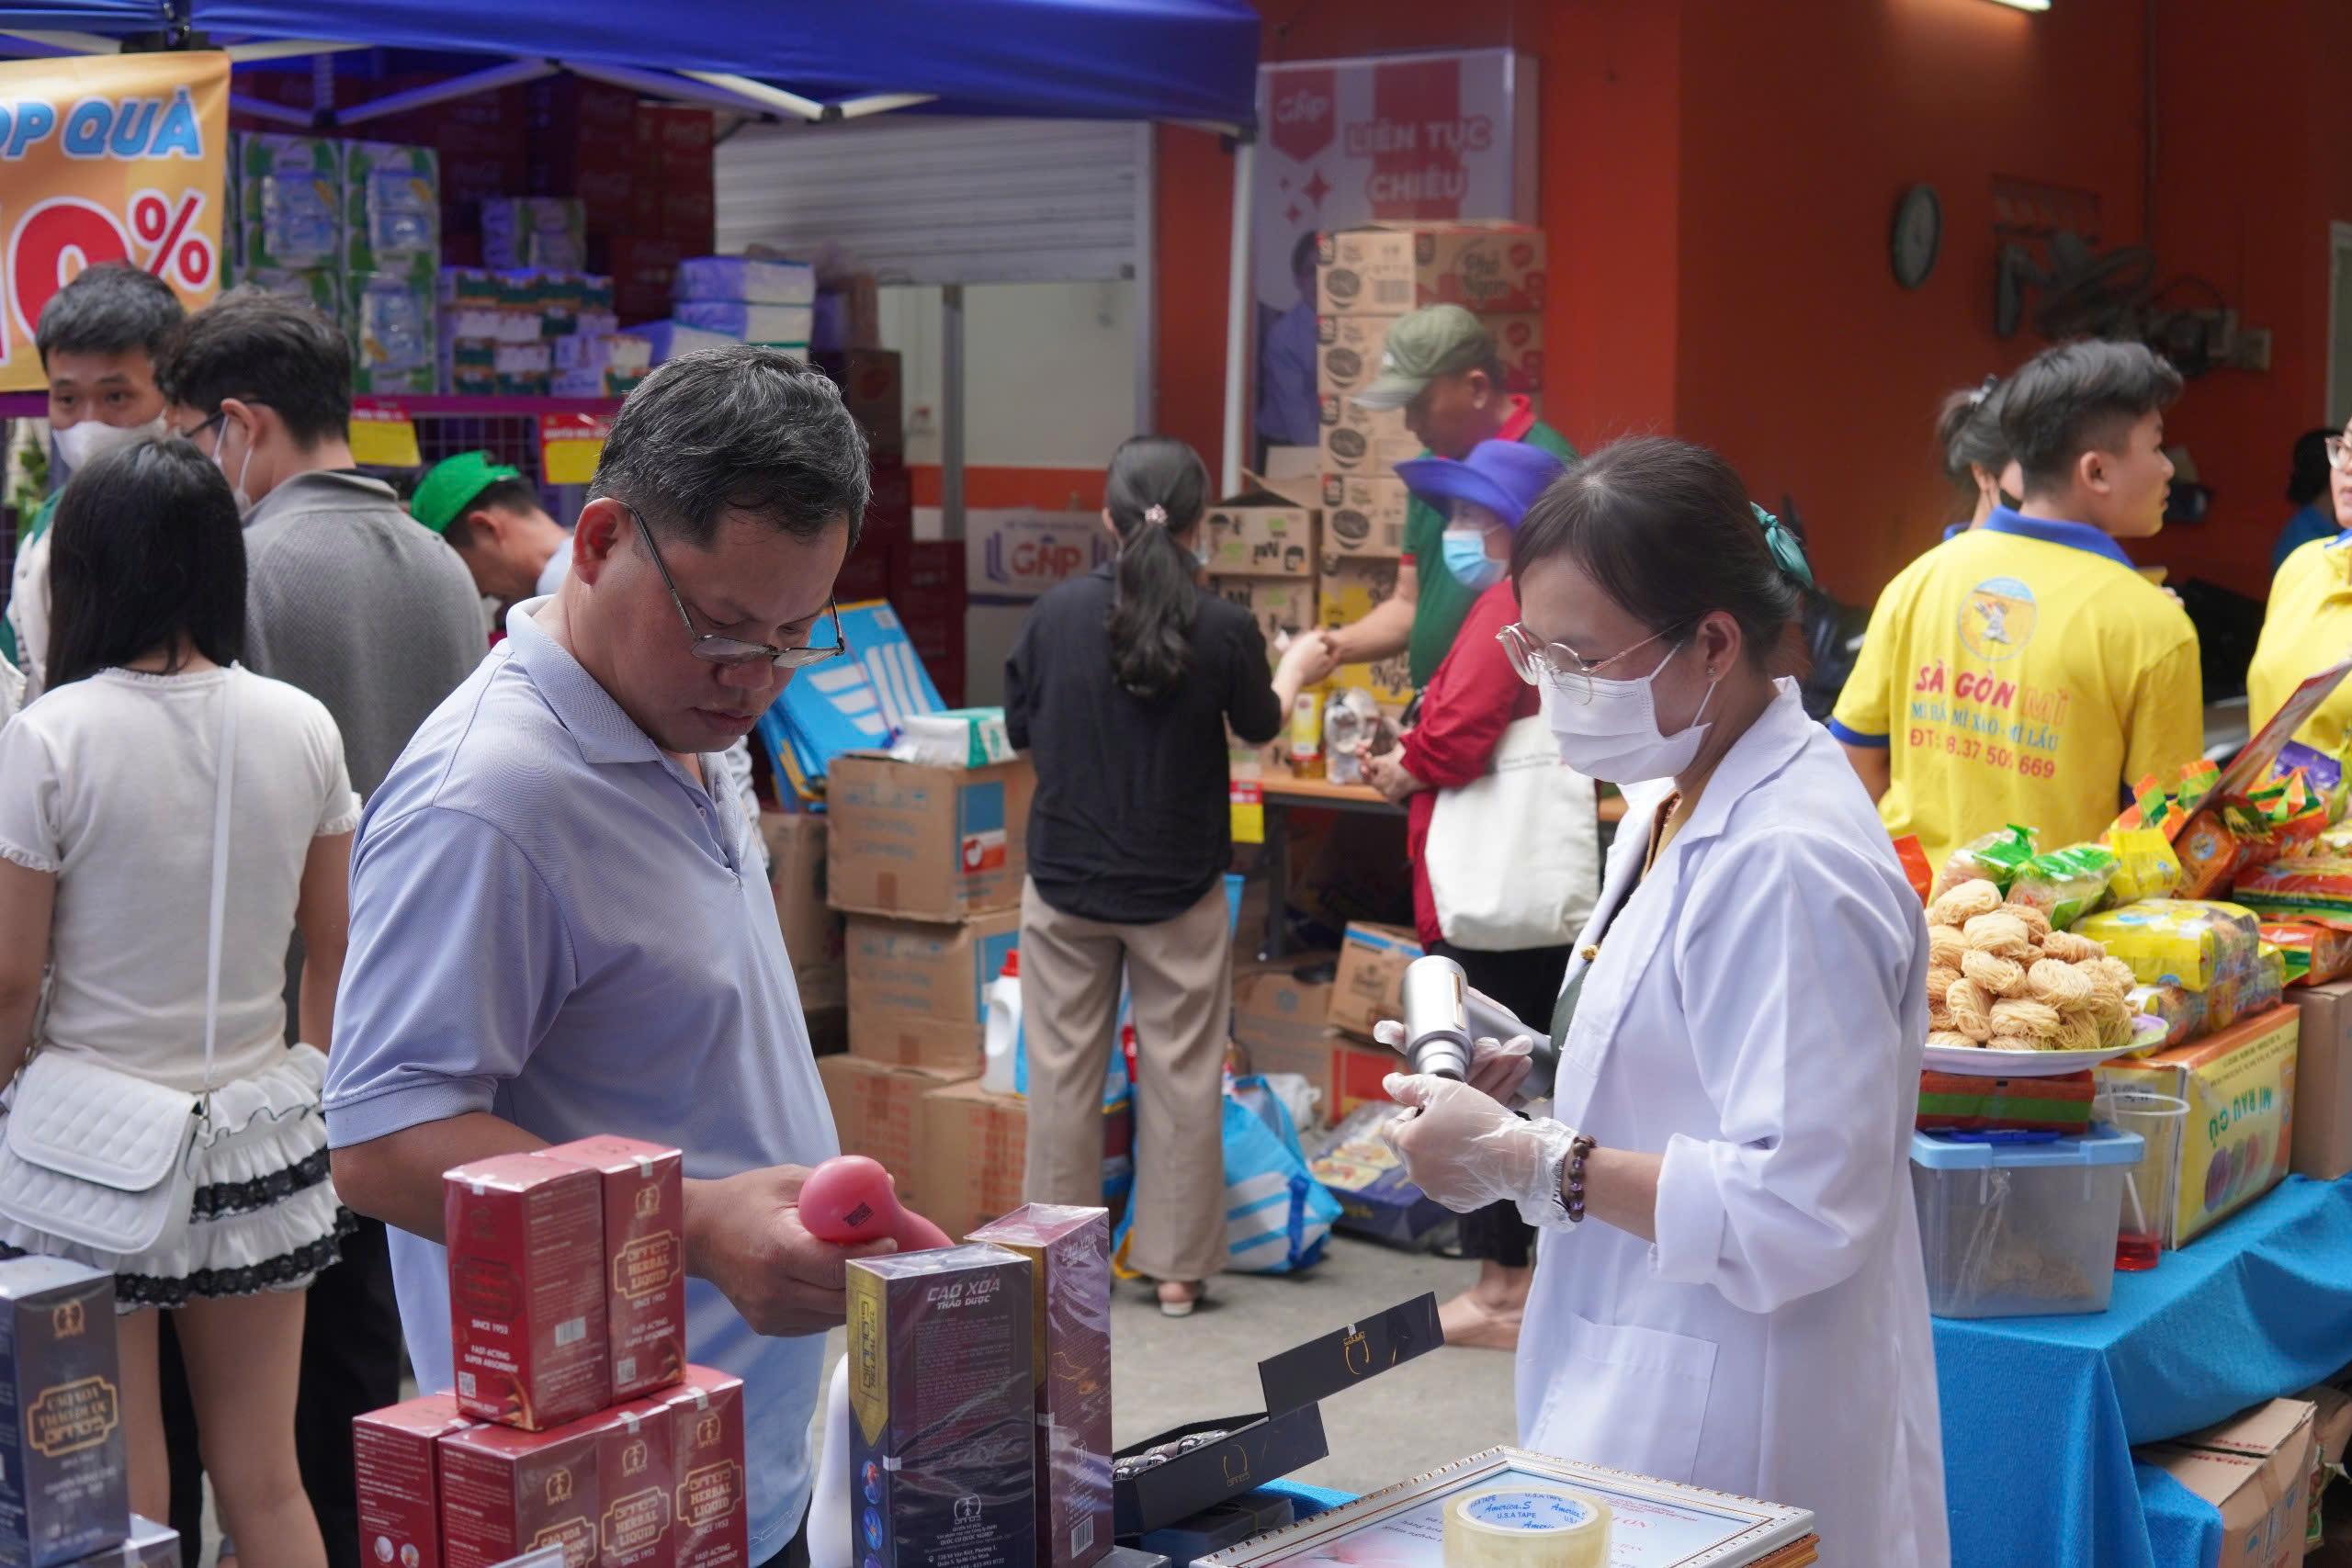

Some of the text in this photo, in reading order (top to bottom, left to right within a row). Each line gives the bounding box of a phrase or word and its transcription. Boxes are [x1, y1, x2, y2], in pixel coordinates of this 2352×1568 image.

[0, 102, 55, 157] P
[0, 195, 210, 359] 0%
[1954, 669, 2017, 709] GÒN
[2018, 754, 2056, 780] 669
[2233, 1088, 2256, 1122] RAU
[926, 1278, 1001, 1303] CAO XOA
[471, 1319, 491, 1331] SINCE
[689, 1483, 733, 1506] HERBAL
[1484, 1500, 1532, 1514] America.S
[693, 1497, 729, 1518] LIQUID
[616, 1509, 659, 1534] HERBAL
[618, 1524, 657, 1548] LIQUID
